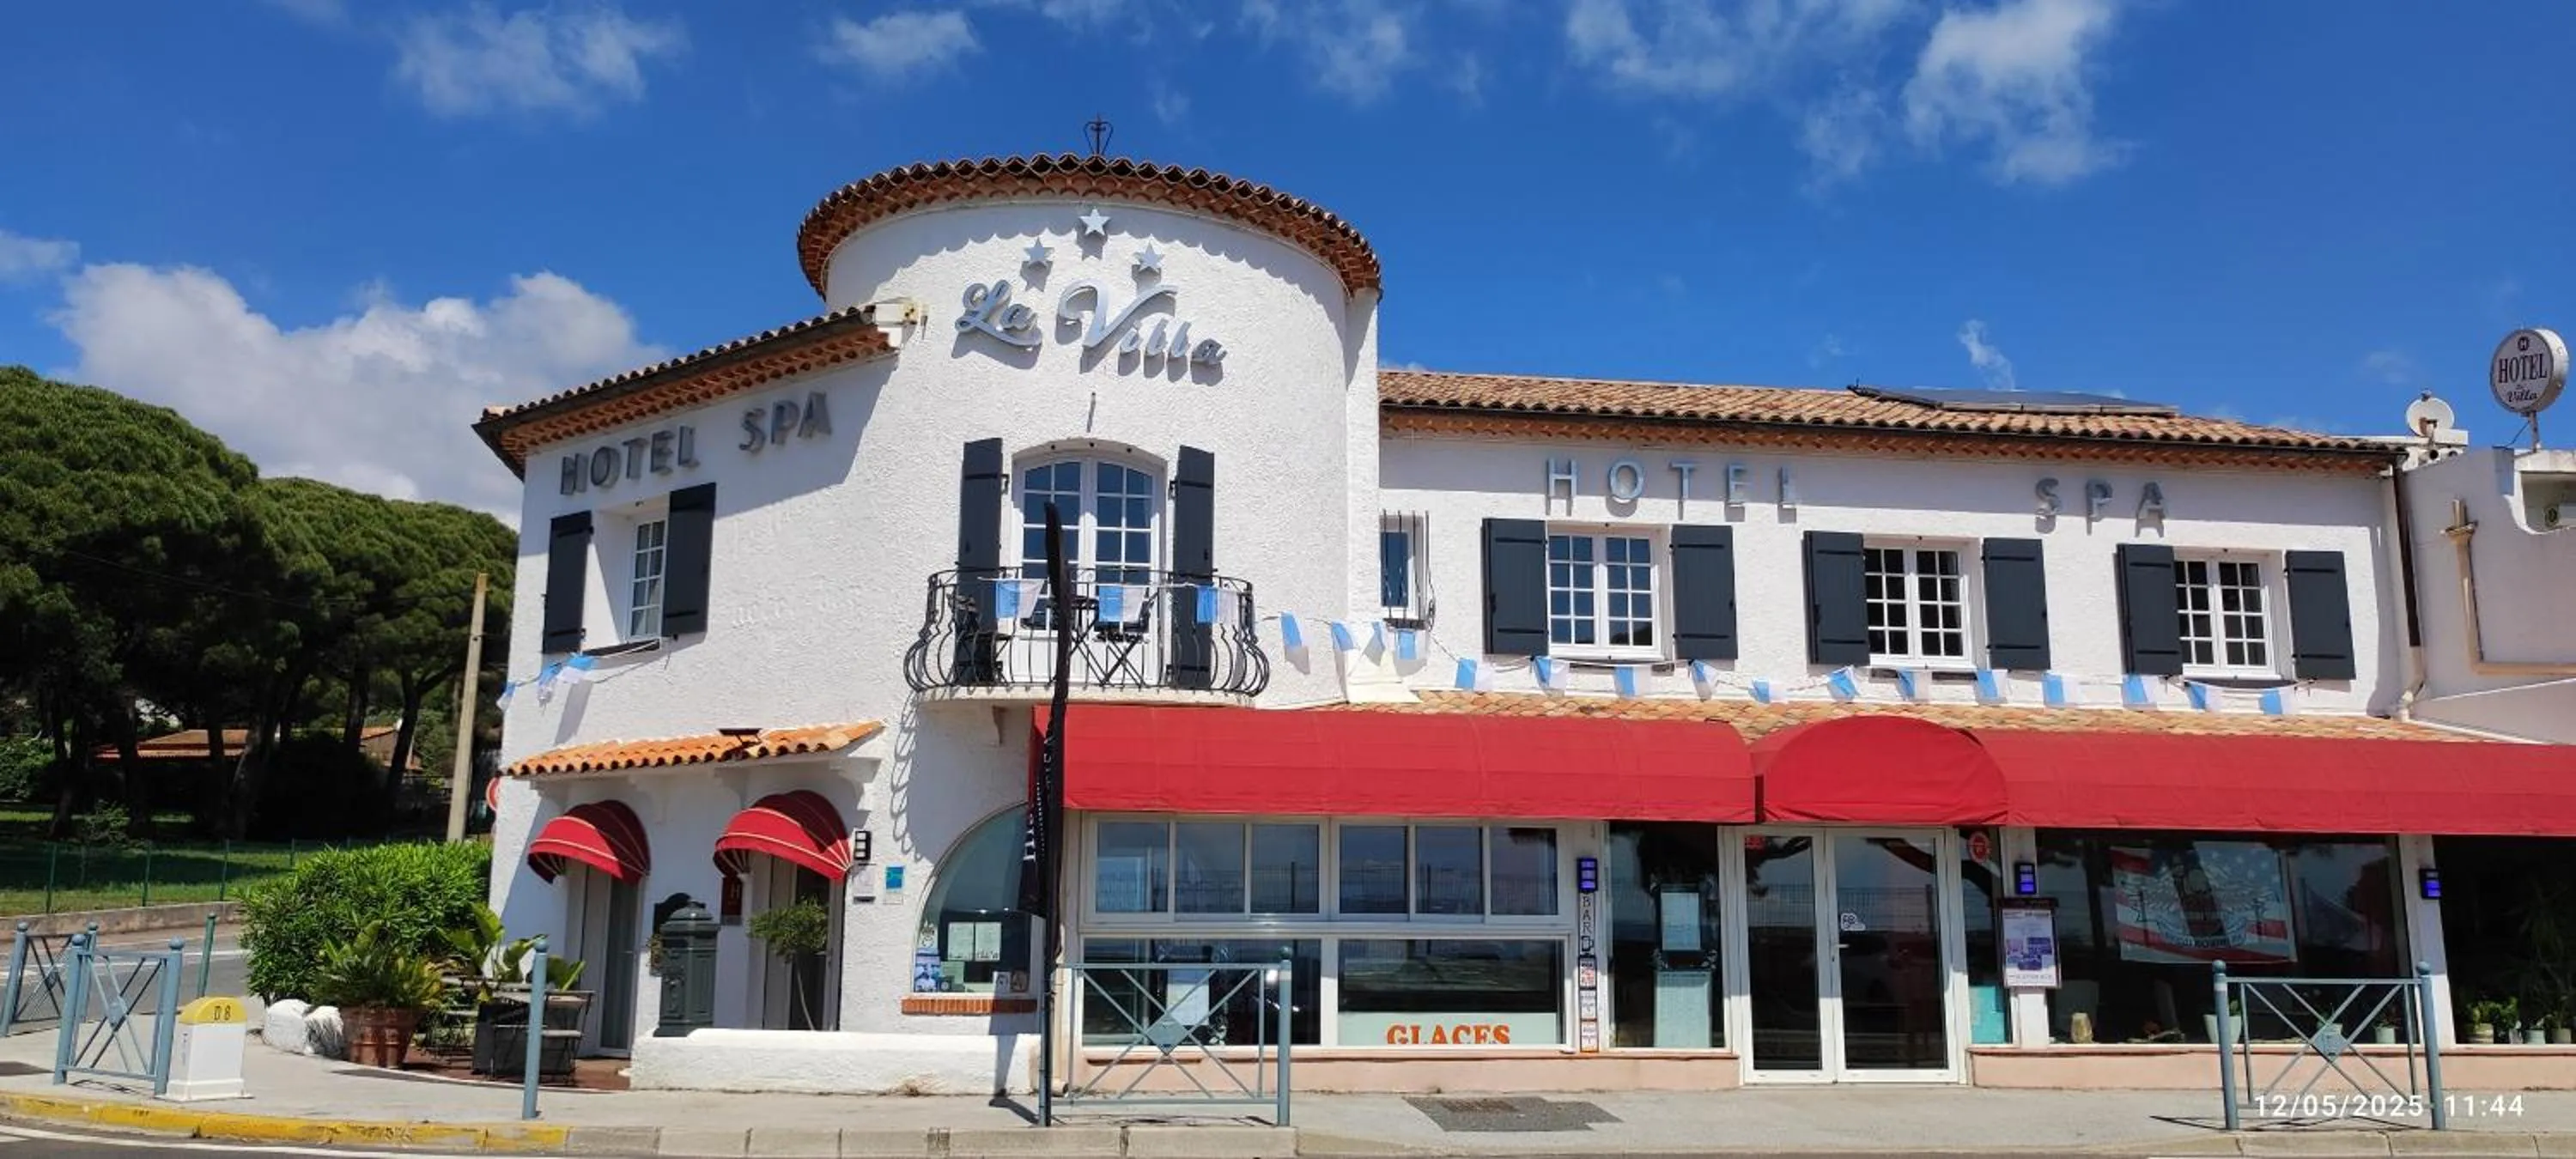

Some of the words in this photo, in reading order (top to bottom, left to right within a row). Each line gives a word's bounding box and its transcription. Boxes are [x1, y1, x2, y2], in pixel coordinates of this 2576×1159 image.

[955, 279, 1042, 346] La
[1057, 277, 1227, 364] Villa
[2498, 353, 2547, 383] HOTEL
[560, 426, 699, 495] HOTEL
[739, 389, 832, 454] SPA
[1546, 458, 1796, 504] HOTEL
[2035, 477, 2167, 520] SPA
[1582, 895, 1593, 934] BAR
[1387, 1024, 1511, 1044] GLACES
